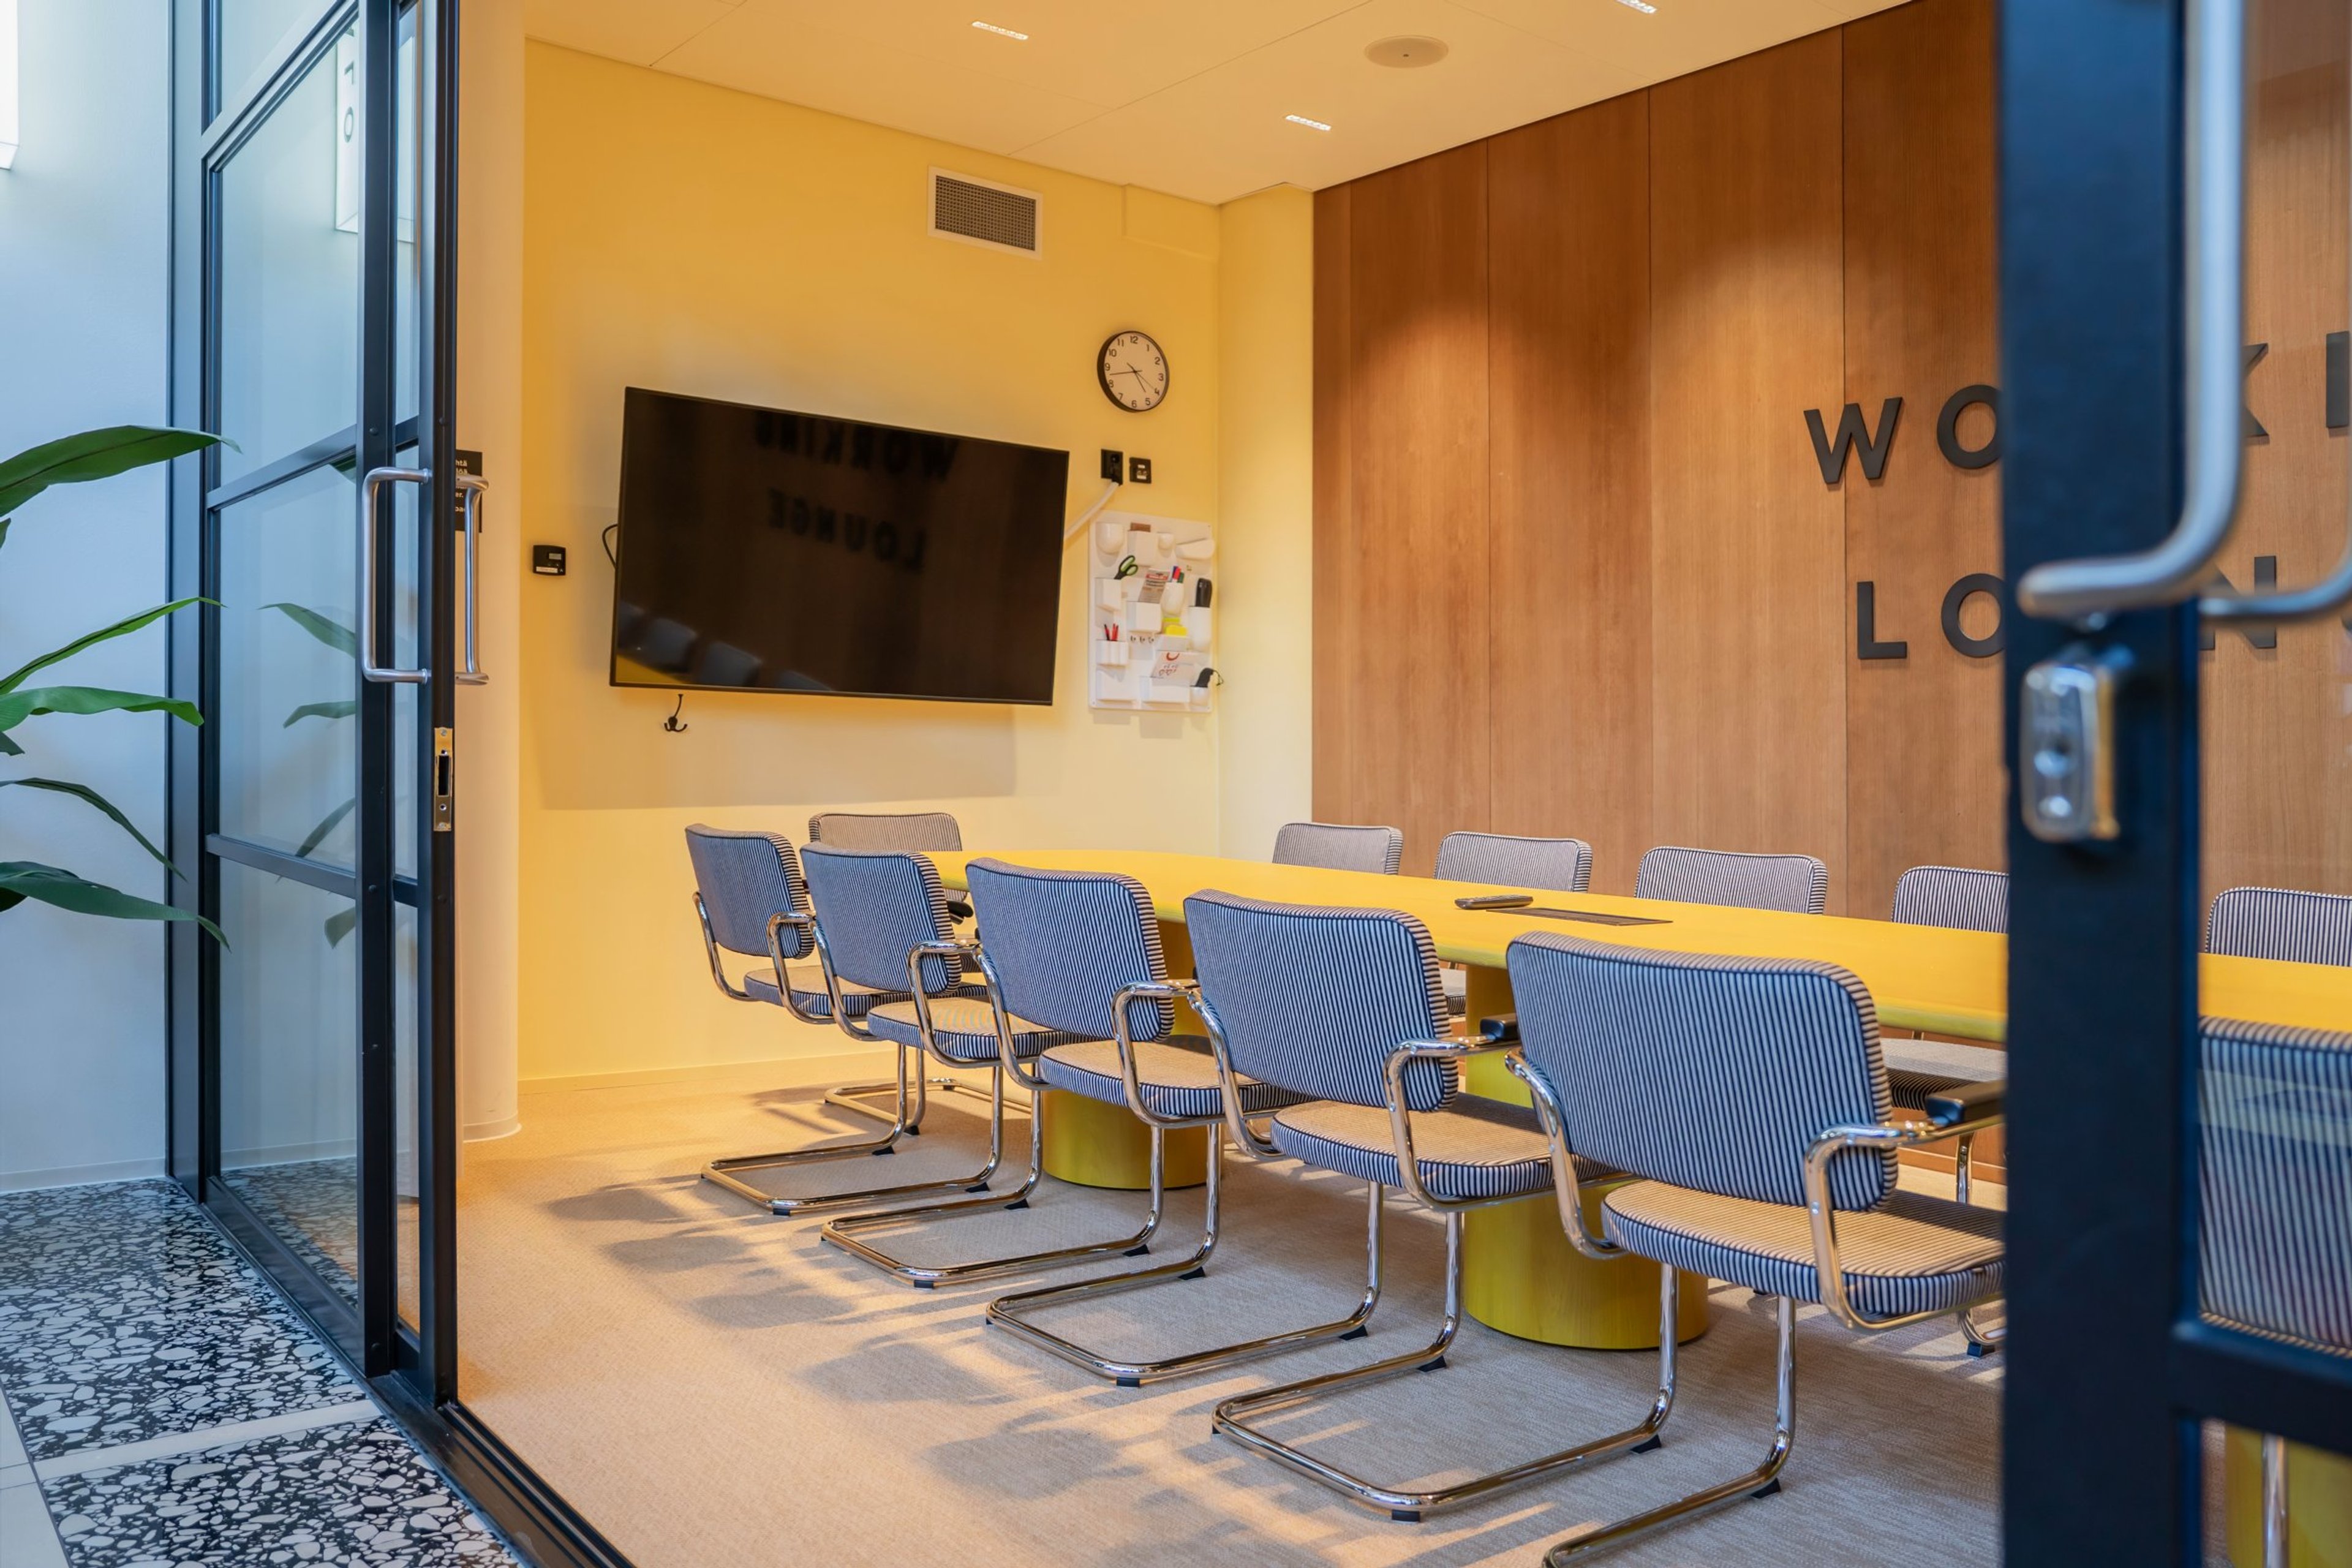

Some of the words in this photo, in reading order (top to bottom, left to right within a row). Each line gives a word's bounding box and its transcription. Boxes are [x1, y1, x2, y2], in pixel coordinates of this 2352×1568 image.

[1117, 338, 1124, 347] 11
[1109, 349, 1117, 357] 10
[1155, 356, 1160, 365] 2
[1105, 363, 1110, 371] 9
[1109, 379, 1114, 388] 8
